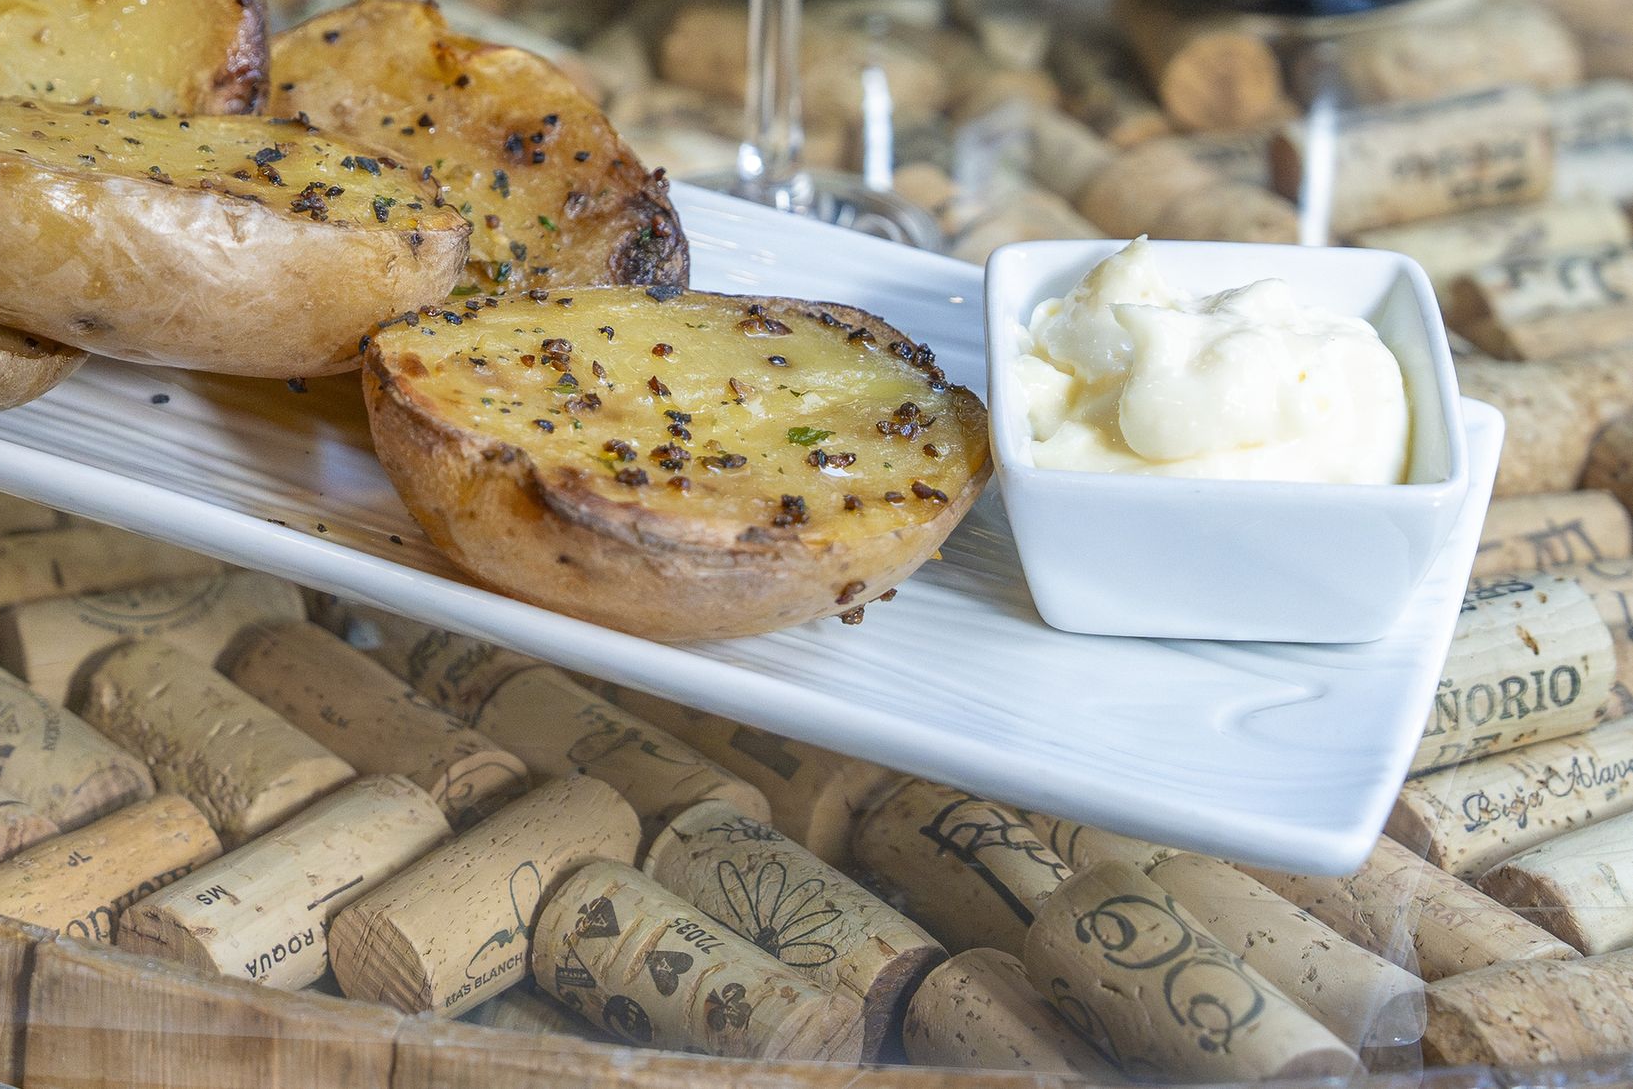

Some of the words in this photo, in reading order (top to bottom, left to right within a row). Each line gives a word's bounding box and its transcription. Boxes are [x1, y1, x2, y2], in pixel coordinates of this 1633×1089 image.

[1423, 665, 1581, 736] ÑORIO
[245, 929, 315, 978] ROQUA
[445, 984, 472, 1007] MAS
[474, 953, 524, 989] BLANCH
